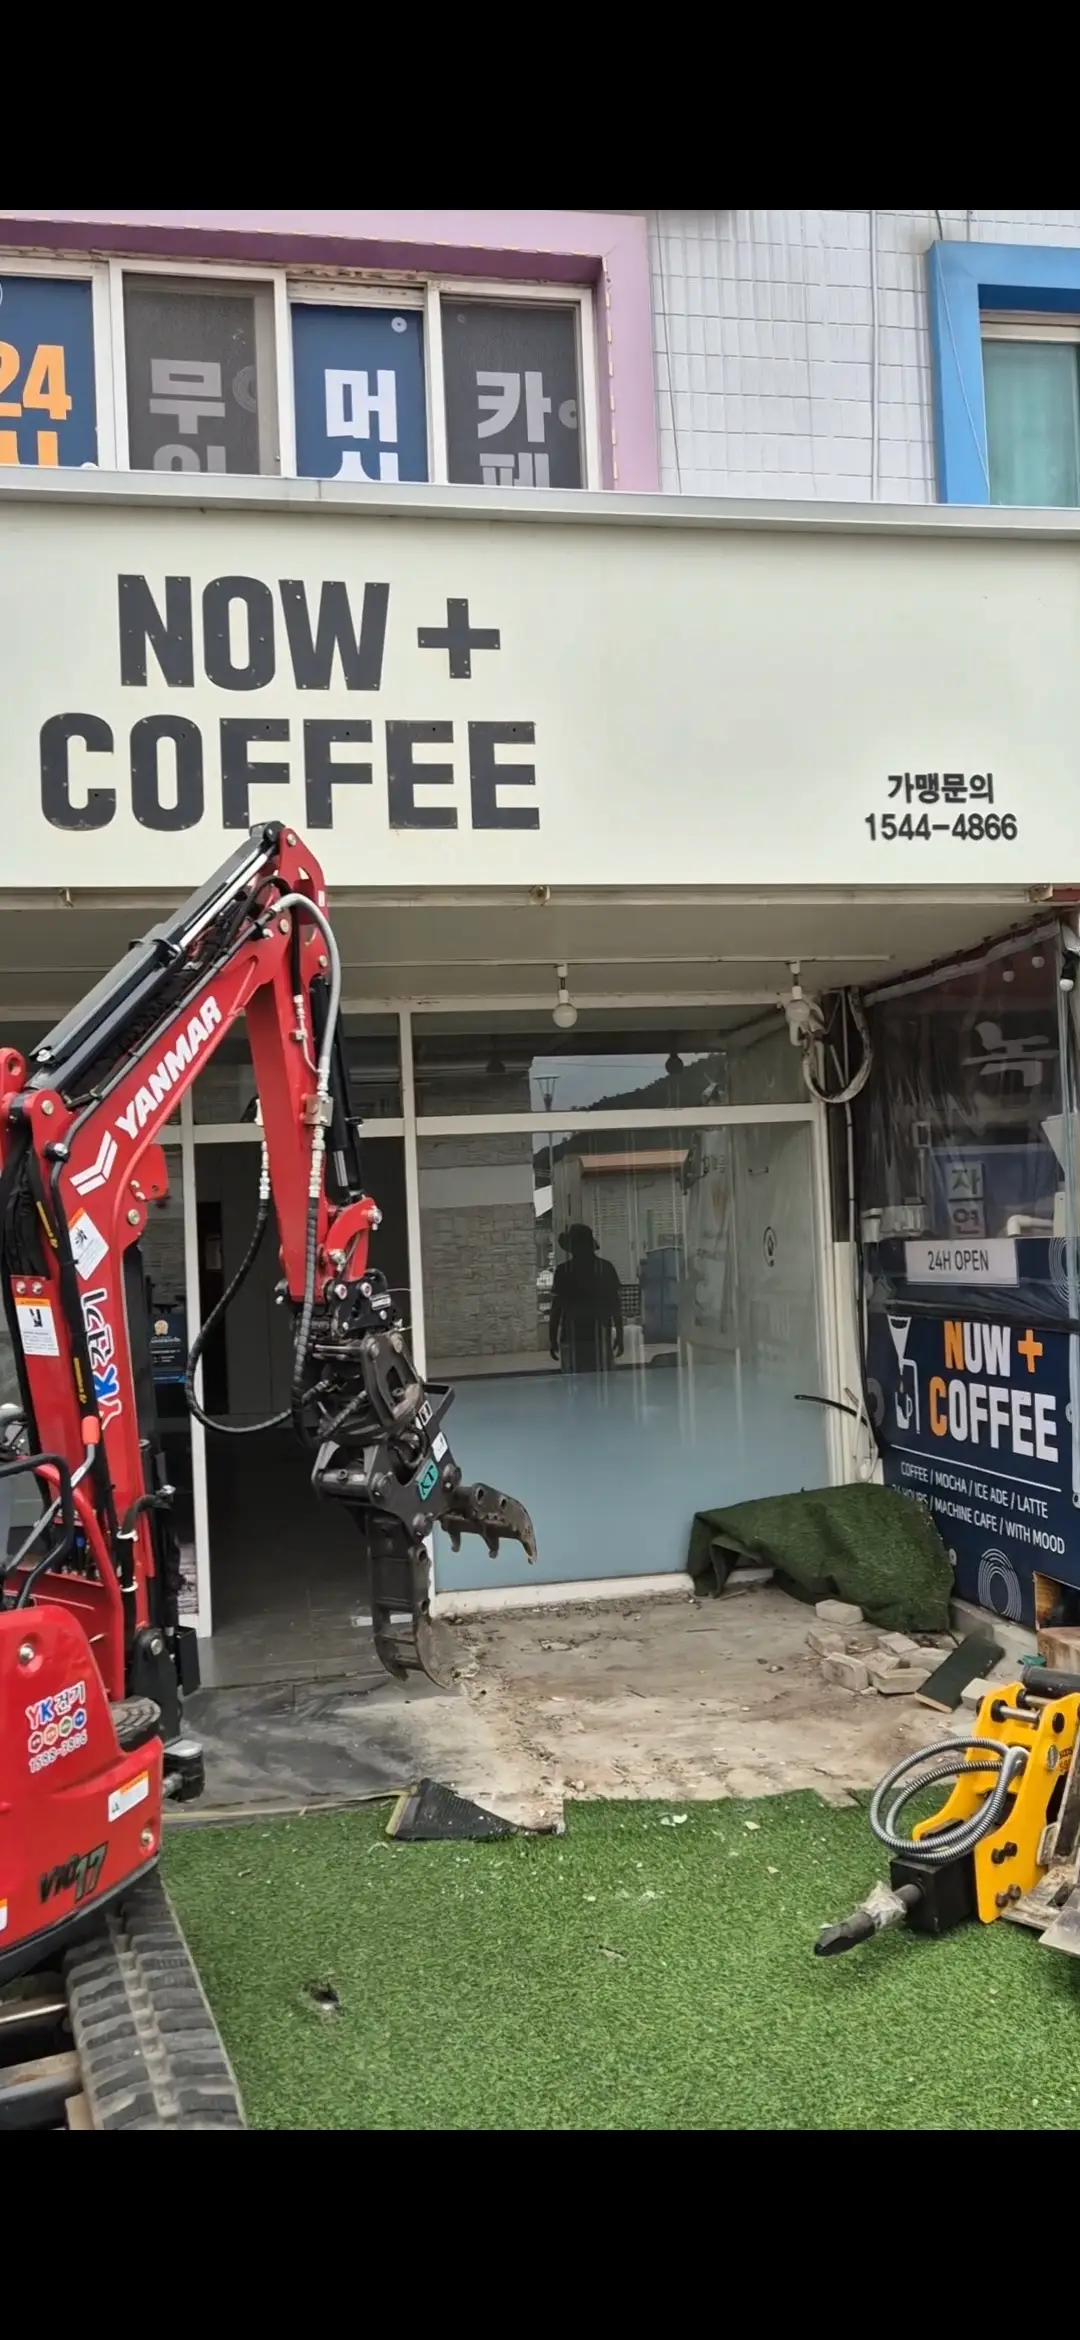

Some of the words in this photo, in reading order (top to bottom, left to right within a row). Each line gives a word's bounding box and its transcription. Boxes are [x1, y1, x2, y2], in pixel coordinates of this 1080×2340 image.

[117, 574, 390, 691] NOW
[39, 712, 540, 831] COFFEE
[887, 772, 994, 804] 가맹문의
[865, 812, 1018, 841] 1544-4866
[114, 995, 222, 1140] YANMAR
[927, 1250, 950, 1271] 24H
[954, 1250, 988, 1271] OPEN
[929, 1376, 1059, 1463] COFFEE
[900, 1461, 929, 1483] COFFEE
[935, 1471, 967, 1495] MOCHA
[974, 1482, 988, 1500] ICE
[989, 1487, 1009, 1507] ADE
[1017, 1494, 1049, 1519] LATTE
[935, 1497, 973, 1524] MACHINE
[973, 1510, 998, 1532] CAFE
[1005, 1520, 1031, 1544] WITH
[1032, 1529, 1066, 1555] MOOD
